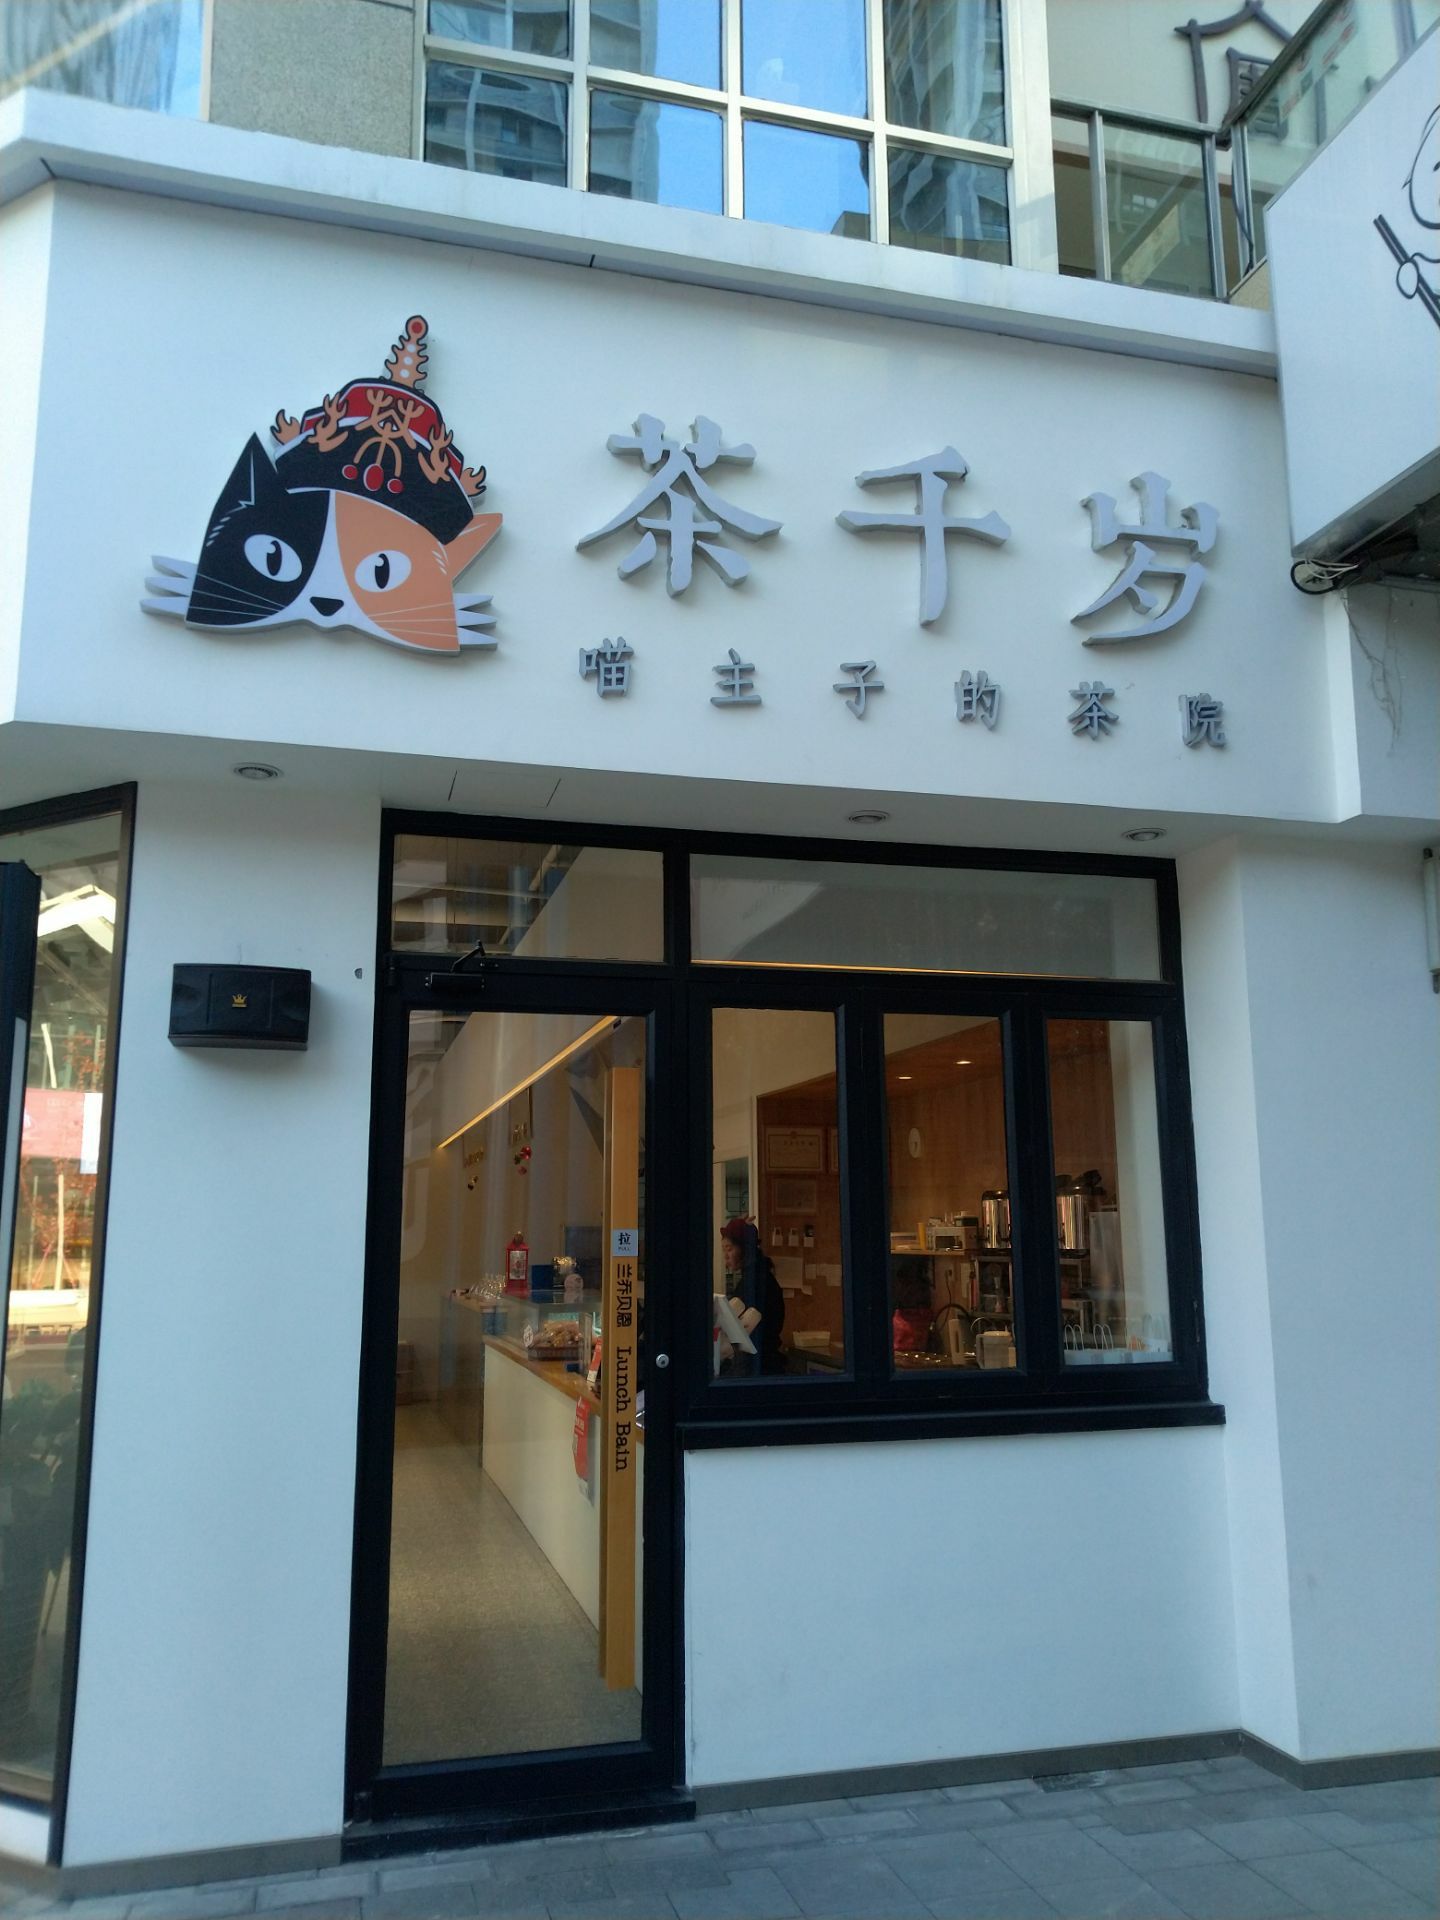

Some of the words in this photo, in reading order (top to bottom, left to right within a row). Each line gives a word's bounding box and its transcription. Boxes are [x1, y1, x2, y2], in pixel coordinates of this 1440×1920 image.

[576, 412, 1220, 648] 茶千岁
[579, 636, 1227, 749] 喵主子的茶院
[618, 1232, 631, 1245] 拉
[616, 1263, 632, 1328] 兰乔贝恩
[616, 1346, 632, 1413] Lunch
[615, 1421, 631, 1472] Bain
